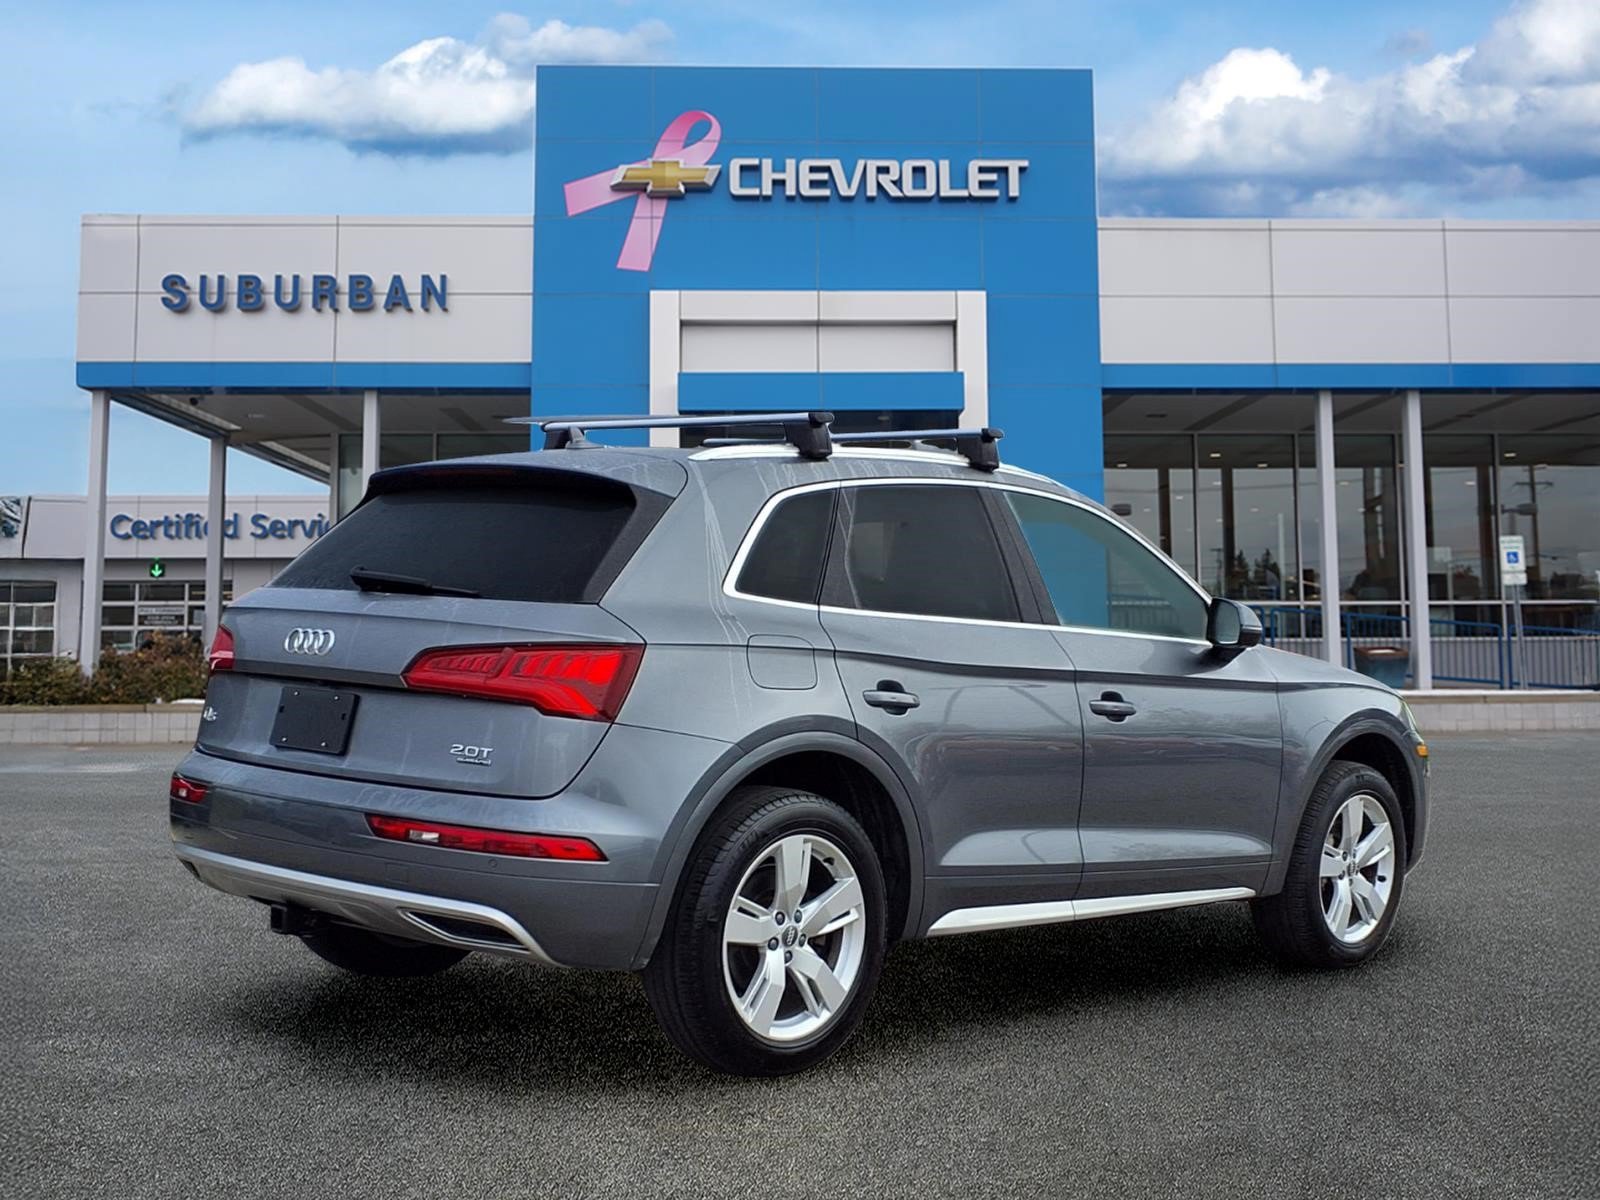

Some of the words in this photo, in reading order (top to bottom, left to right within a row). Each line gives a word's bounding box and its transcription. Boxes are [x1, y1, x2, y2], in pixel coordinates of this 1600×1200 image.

[729, 157, 1029, 199] CHEVROLET
[160, 274, 449, 313] SUBURBAN
[110, 513, 240, 540] Certifid
[250, 513, 330, 540] Servi
